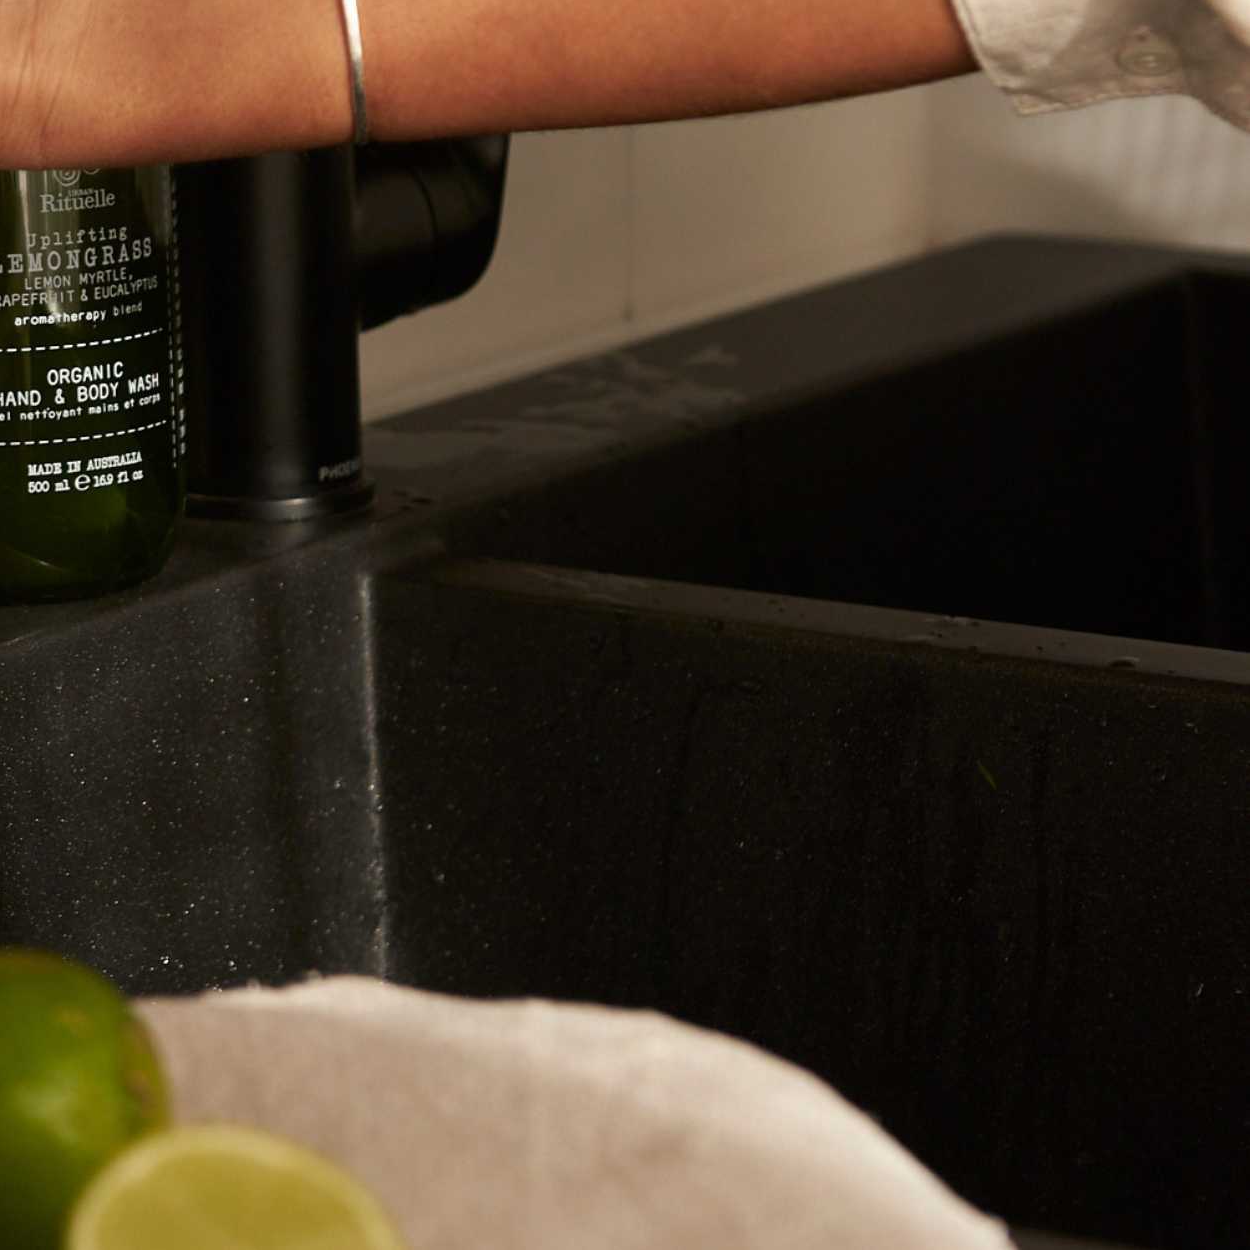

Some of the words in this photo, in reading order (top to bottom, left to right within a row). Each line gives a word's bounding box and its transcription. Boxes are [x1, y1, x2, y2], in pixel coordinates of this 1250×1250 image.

[40, 189, 116, 213] Rituelle
[27, 226, 128, 249] Uplifting
[25, 275, 71, 290] LEMON
[79, 267, 133, 285] MYRTLE,
[80, 289, 88, 301] &
[94, 275, 158, 300] EUCALYPTUS
[14, 309, 106, 326] aromatherapy
[113, 302, 143, 317] blend
[47, 361, 124, 386] ORGANIC
[54, 388, 65, 404] &
[77, 382, 119, 402] BODY
[128, 373, 159, 393] WASH
[20, 407, 82, 421] nettoyant
[88, 403, 119, 415] mains
[124, 398, 134, 409] et
[139, 393, 161, 406] corps
[28, 462, 62, 476] MADE
[67, 460, 81, 473] IN
[86, 451, 143, 471] AUSTRALIA
[28, 481, 50, 493] 500
[54, 479, 70, 491] ml
